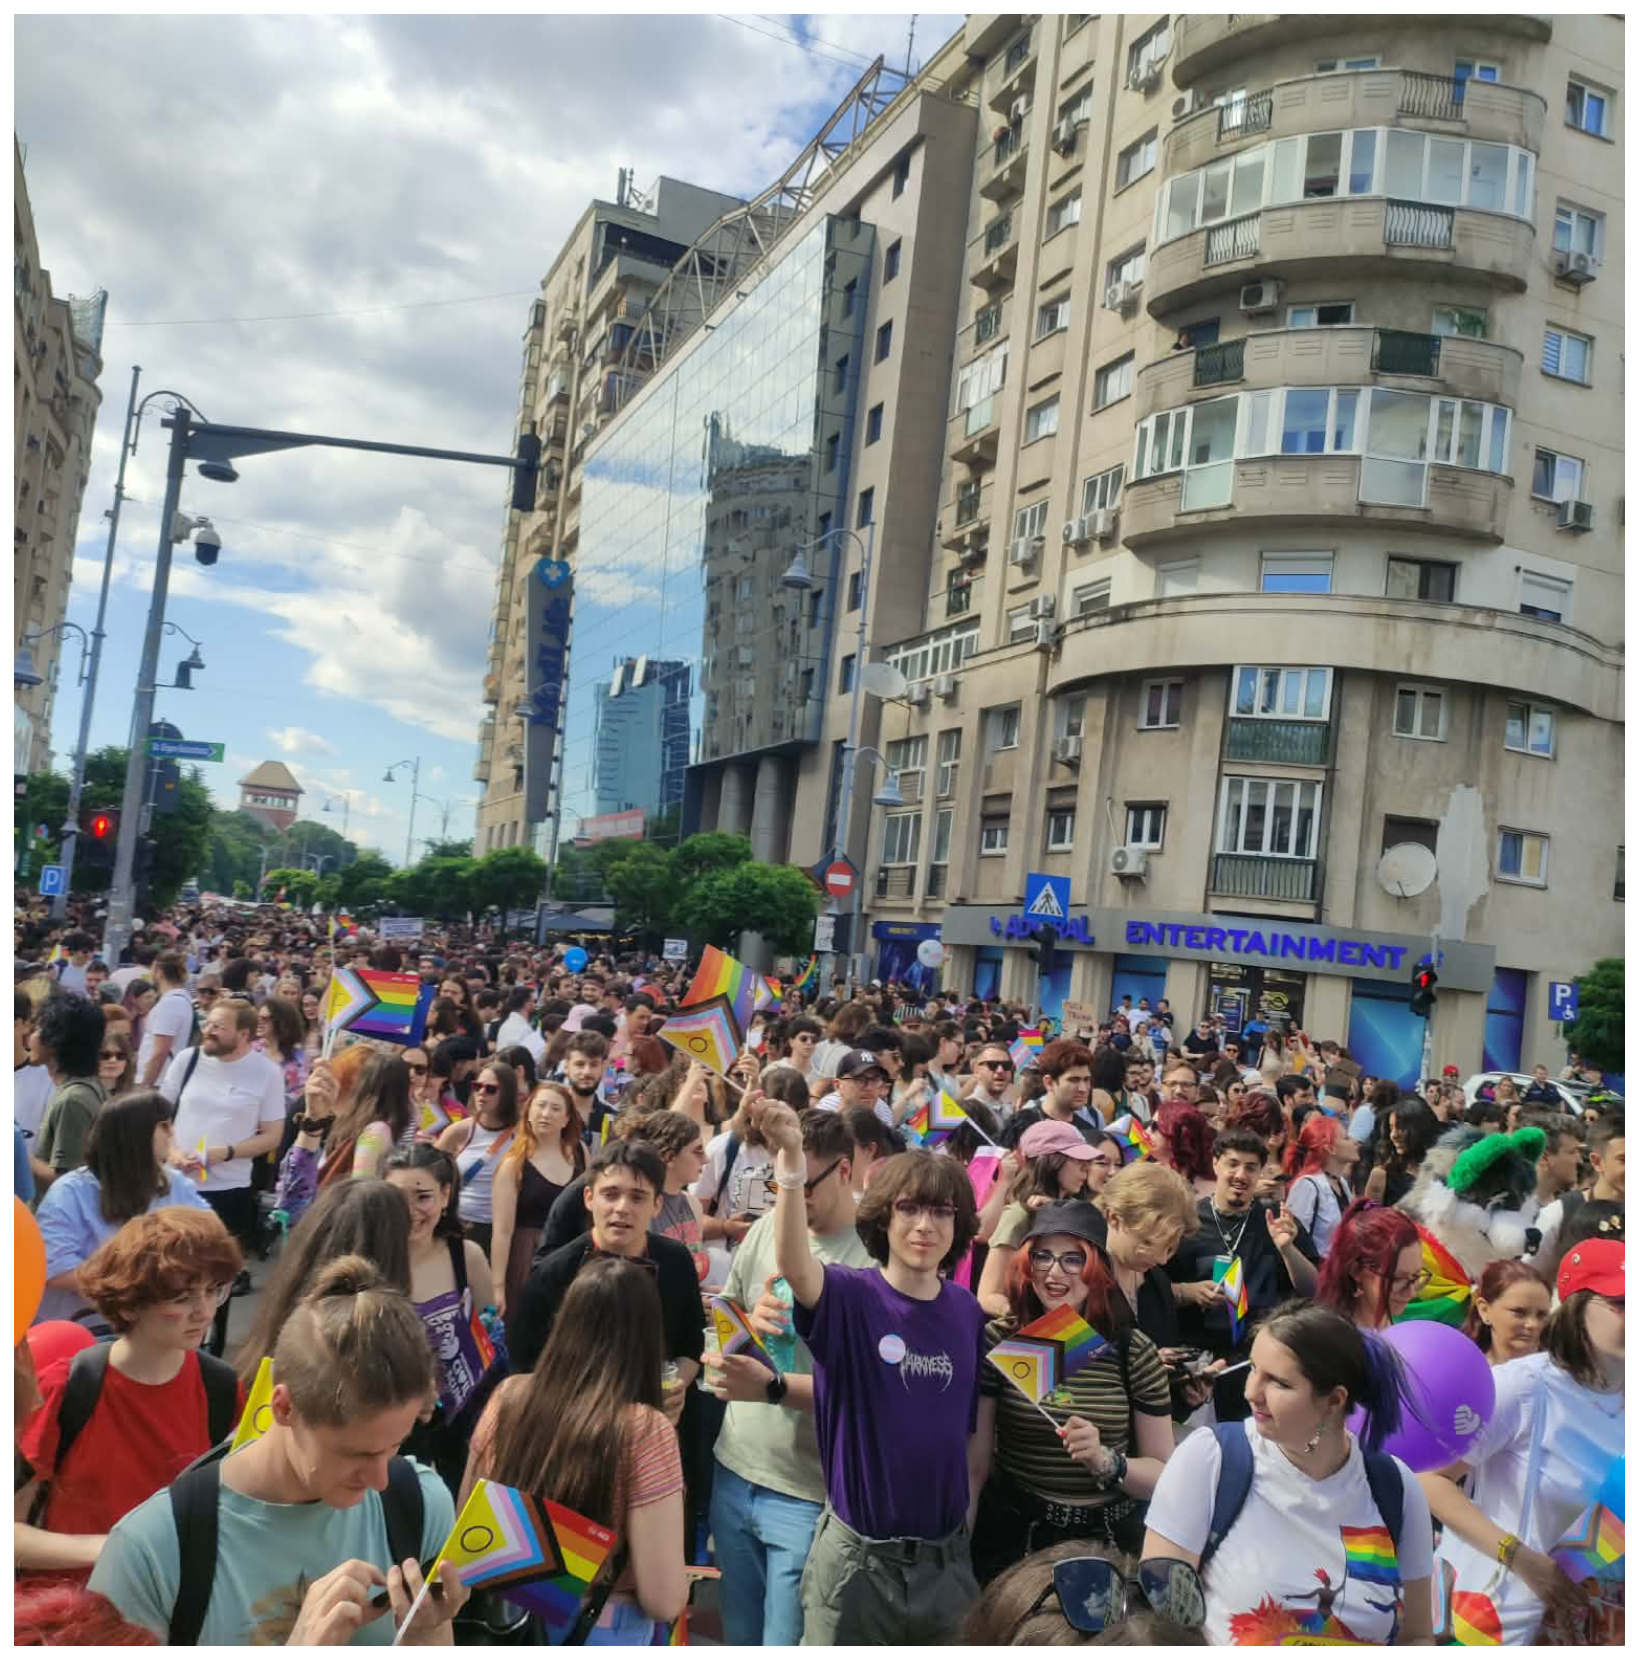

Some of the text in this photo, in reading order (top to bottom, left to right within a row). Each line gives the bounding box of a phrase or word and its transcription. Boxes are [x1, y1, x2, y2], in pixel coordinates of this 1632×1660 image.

[45, 870, 59, 890] P
[1003, 914, 1408, 970] ADRAL ENTERTAINMENT
[1556, 984, 1571, 1006] P
